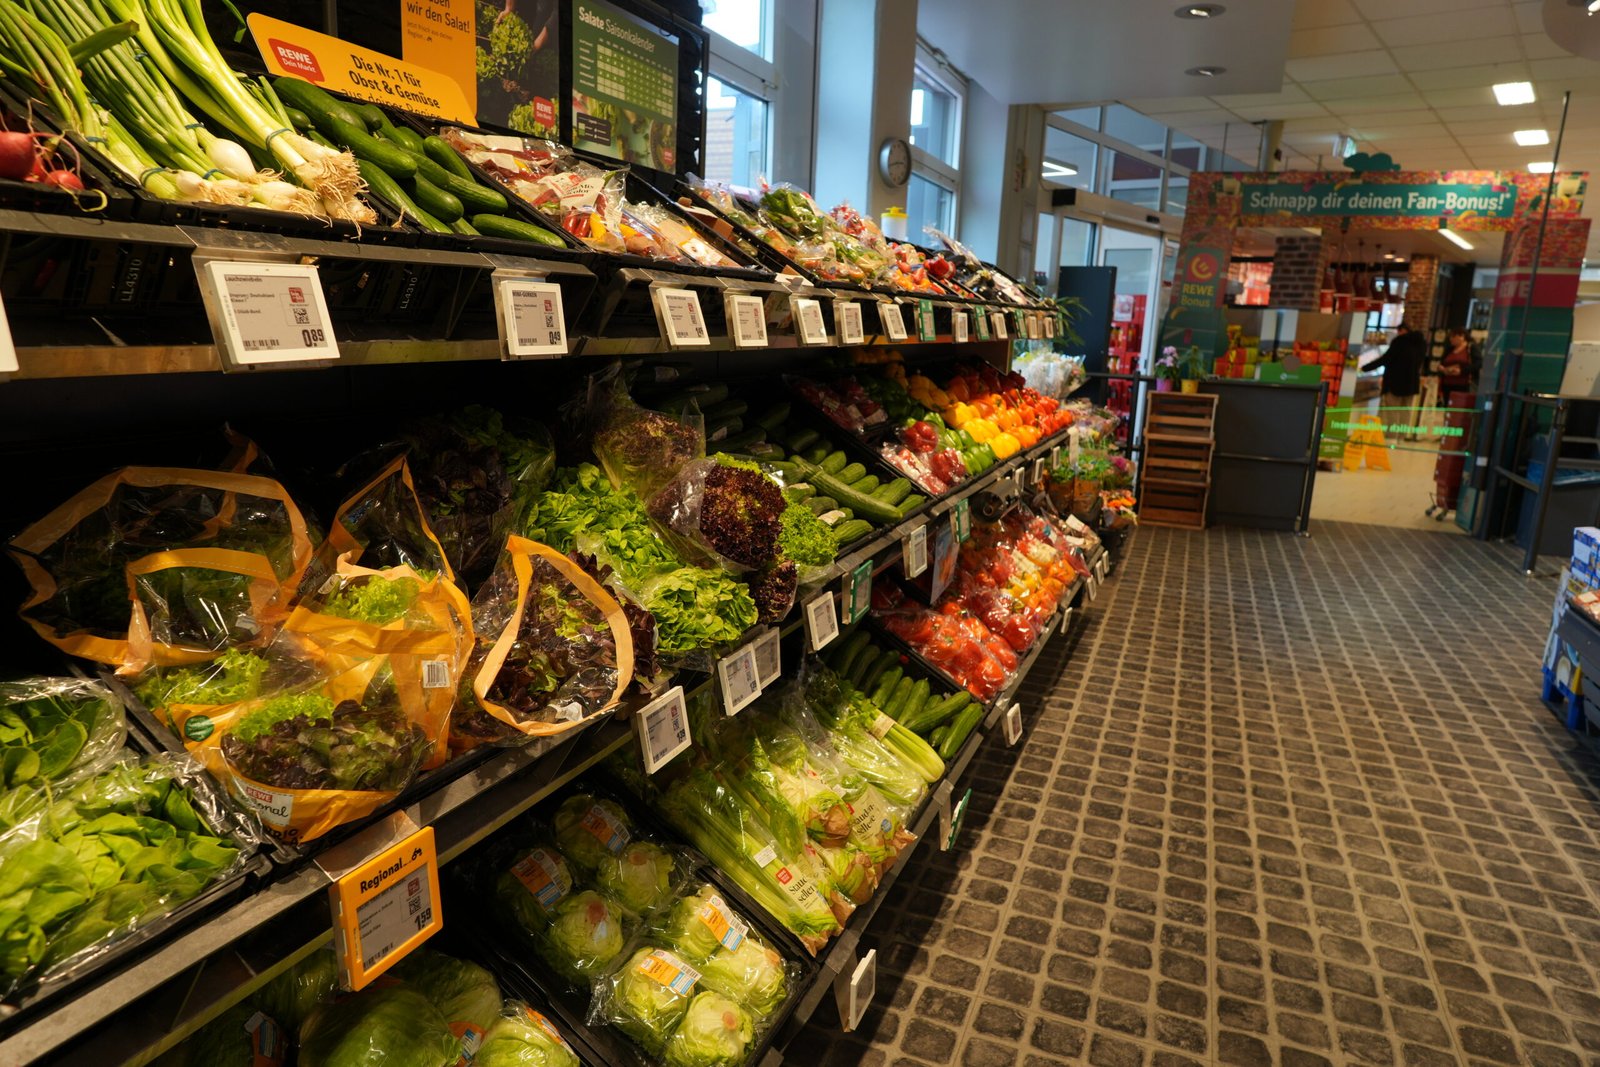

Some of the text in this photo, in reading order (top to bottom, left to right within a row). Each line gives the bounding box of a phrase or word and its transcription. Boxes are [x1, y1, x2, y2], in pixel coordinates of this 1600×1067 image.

[406, 2, 470, 33] wir den Salat!
[579, 7, 656, 53] Salate Saisonkalender
[277, 46, 313, 65] REWE
[282, 57, 317, 73] Dein Markt
[350, 54, 422, 88] Die Nr. 1 für
[349, 70, 382, 92] Obst
[381, 80, 395, 95] &
[394, 84, 440, 109] Gemüse
[1250, 191, 1317, 212] Schnapp
[1322, 191, 1344, 208] dir
[1348, 192, 1402, 209] deinen
[120, 259, 143, 302] LL4310
[399, 276, 418, 309] LL4310
[1183, 283, 1214, 297] REWE
[1181, 295, 1210, 308] Bonus
[247, 787, 272, 802] REWE
[360, 858, 403, 894] Regional
